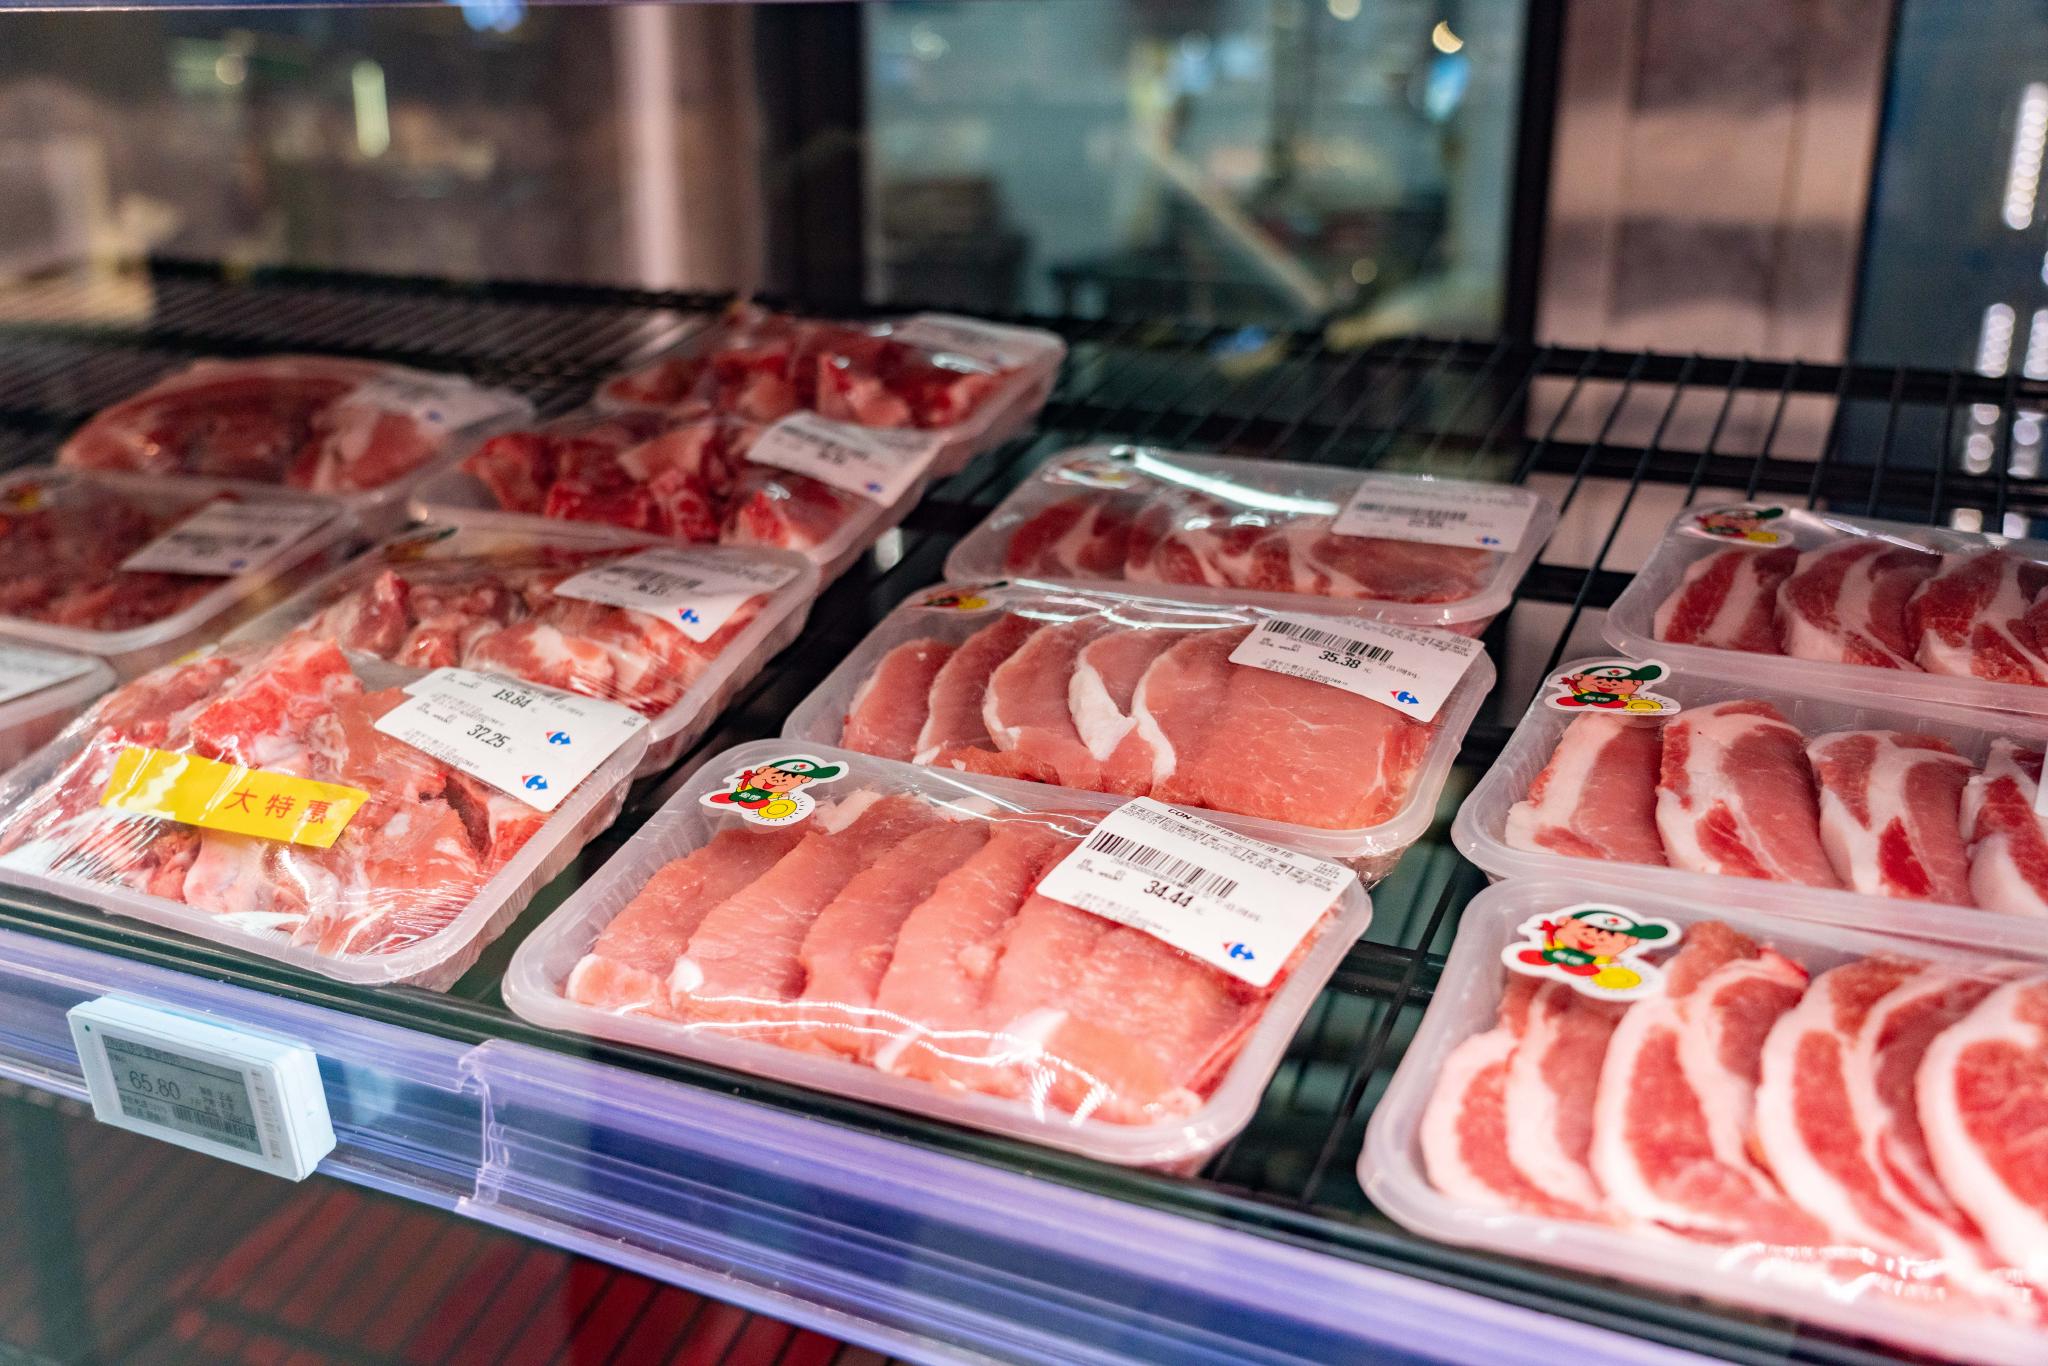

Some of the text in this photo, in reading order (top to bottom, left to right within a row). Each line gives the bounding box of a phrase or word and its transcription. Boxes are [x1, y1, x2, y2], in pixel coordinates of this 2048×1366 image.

[1319, 650, 1361, 669] 35.38
[492, 689, 533, 708] 19.84
[467, 724, 511, 749] 37.25
[224, 788, 333, 824] 大特惠
[1143, 880, 1194, 909] 34.44
[129, 1070, 181, 1100] 65.80
